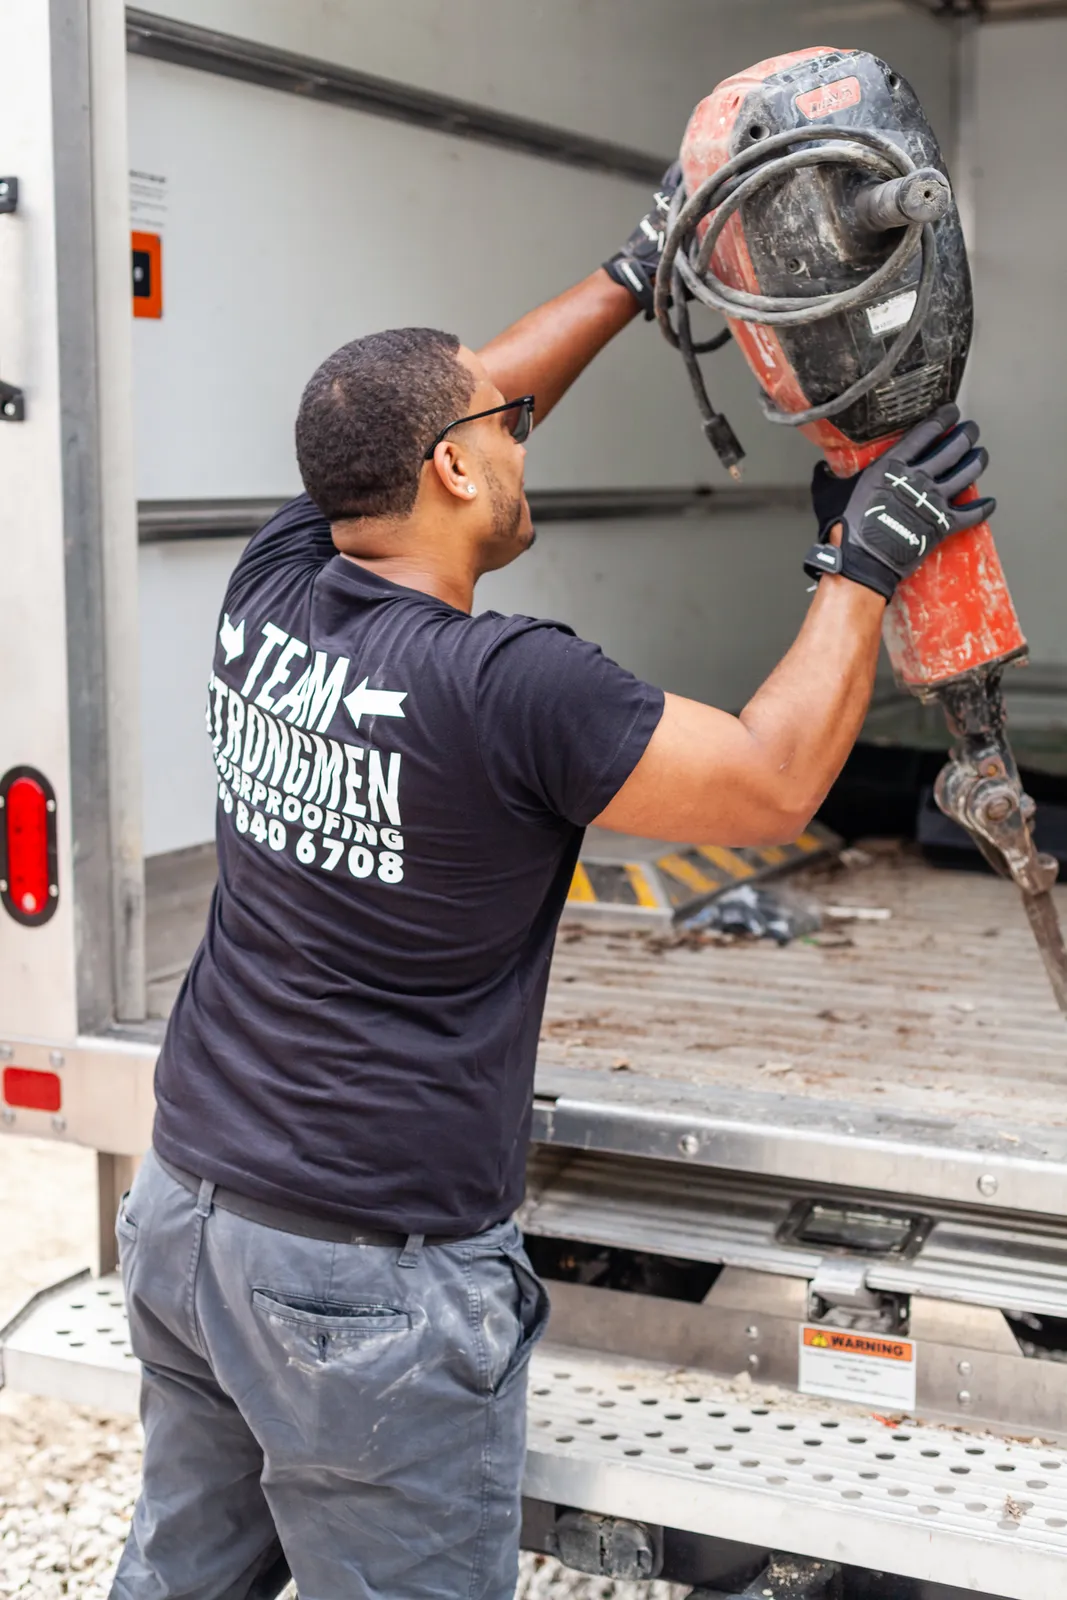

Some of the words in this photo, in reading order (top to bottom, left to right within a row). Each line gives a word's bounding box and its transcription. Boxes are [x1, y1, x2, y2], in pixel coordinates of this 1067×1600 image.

[241, 621, 350, 734] TEAM
[236, 799, 287, 852] 840
[296, 833, 404, 884] 6708
[832, 1336, 903, 1356] WARNING
